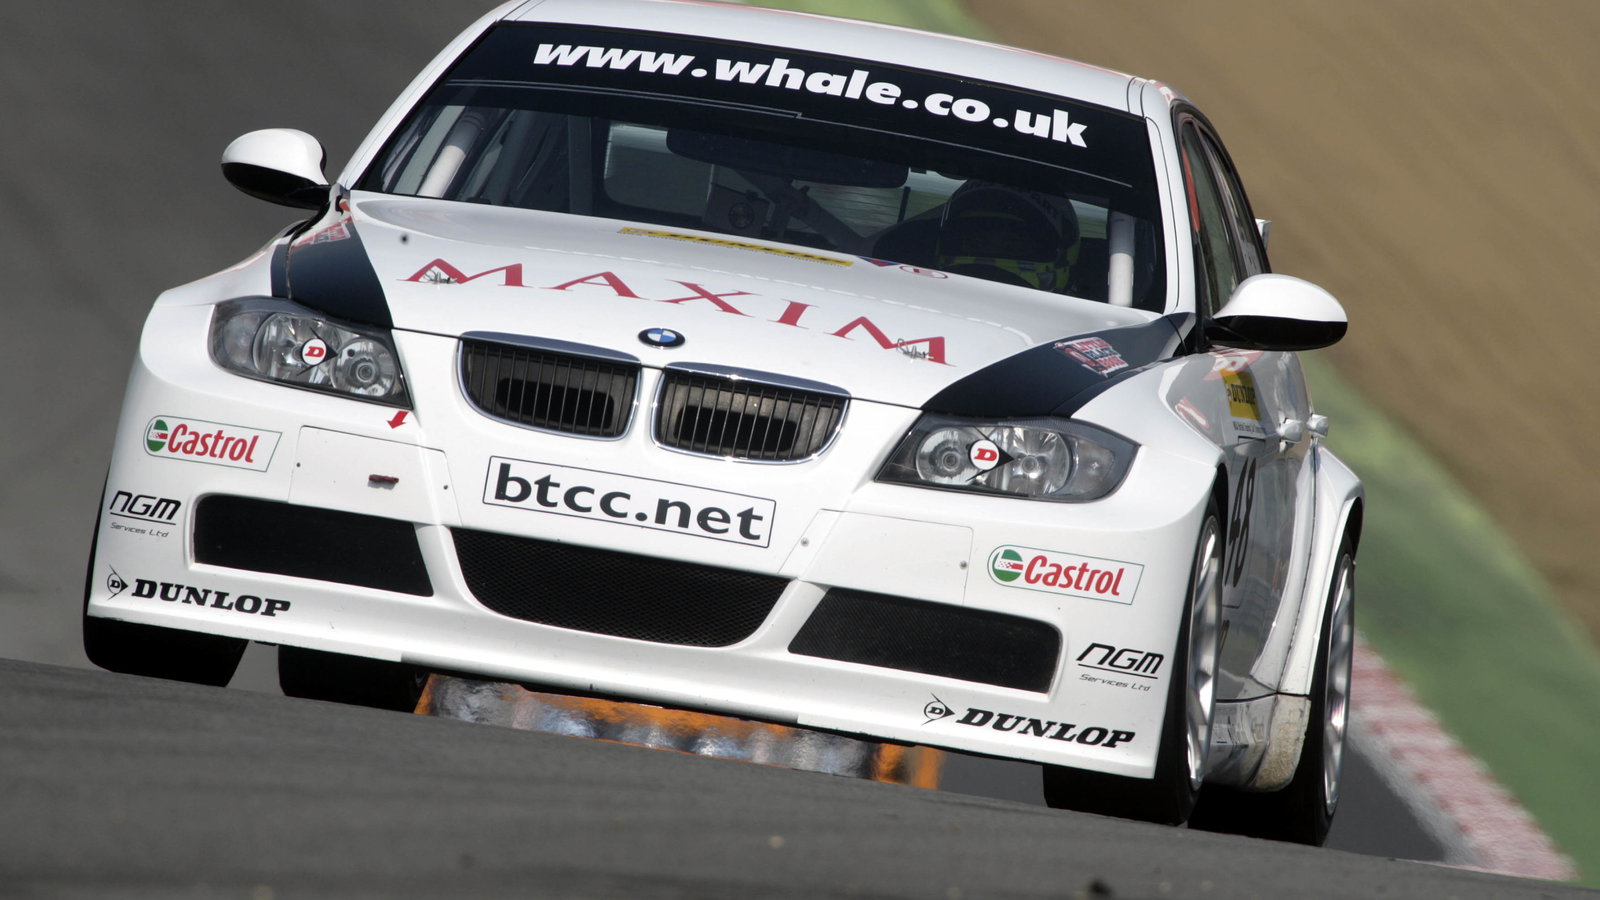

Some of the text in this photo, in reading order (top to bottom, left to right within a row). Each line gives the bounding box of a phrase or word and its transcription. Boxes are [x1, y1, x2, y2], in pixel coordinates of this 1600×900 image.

[533, 43, 1088, 148] www.whale.co.uk
[398, 258, 954, 366] MAXIM
[167, 423, 260, 463] Castrol
[495, 462, 763, 540] btcc.net
[110, 522, 169, 538] Services Ltd
[1024, 555, 1125, 596] Castrol
[131, 578, 291, 617] DUNLOP
[1079, 673, 1152, 692] Services Ltd
[956, 707, 1136, 749] DUNLOP
